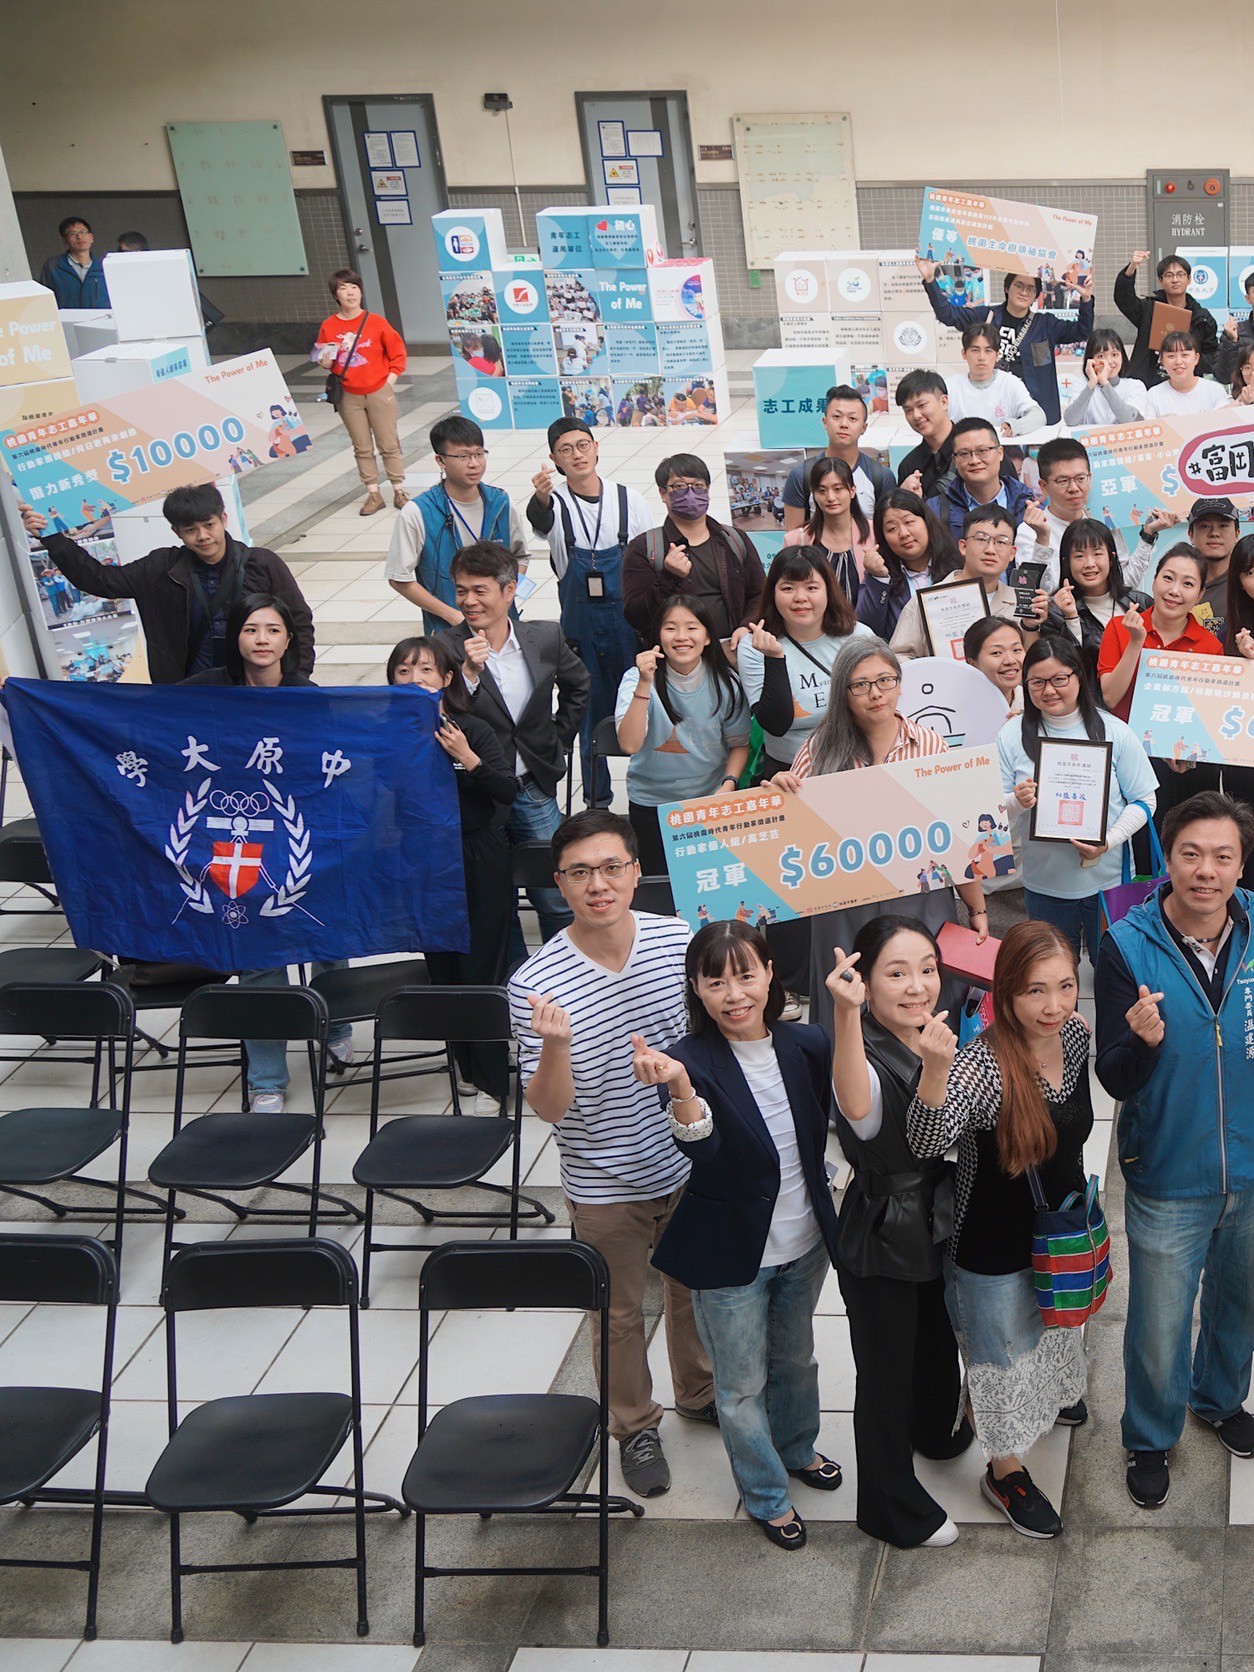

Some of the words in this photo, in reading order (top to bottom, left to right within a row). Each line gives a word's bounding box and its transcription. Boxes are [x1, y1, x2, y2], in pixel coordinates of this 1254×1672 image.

[615, 220, 635, 230] 初心
[1171, 213, 1205, 226] 消防栓
[931, 228, 958, 243] 優等
[1171, 227, 1205, 237] HYDRANT
[599, 282, 617, 292] The
[620, 282, 647, 292] Power
[611, 298, 622, 309] of
[626, 298, 643, 310] Me
[9, 320, 57, 337] Power
[24, 344, 53, 364] Me
[204, 374, 221, 385] The
[221, 366, 246, 380] Power
[246, 362, 255, 372] of
[256, 358, 269, 369] Me
[6, 411, 99, 448] 桃園青年志工嘉年華
[107, 415, 247, 484] $10000
[29, 468, 98, 500] 潛力新秀獎
[1101, 475, 1138, 496] 亞軍
[1149, 657, 1243, 675] 桃園青年志工嘉年華
[1150, 703, 1196, 724] 冠軍
[915, 767, 932, 779] The
[934, 760, 963, 776] Power
[964, 758, 975, 771] of
[976, 756, 990, 767] Me
[670, 795, 782, 826] 桃園青年志工嘉年華
[779, 820, 953, 890] $60000
[696, 862, 747, 893] 冠軍
